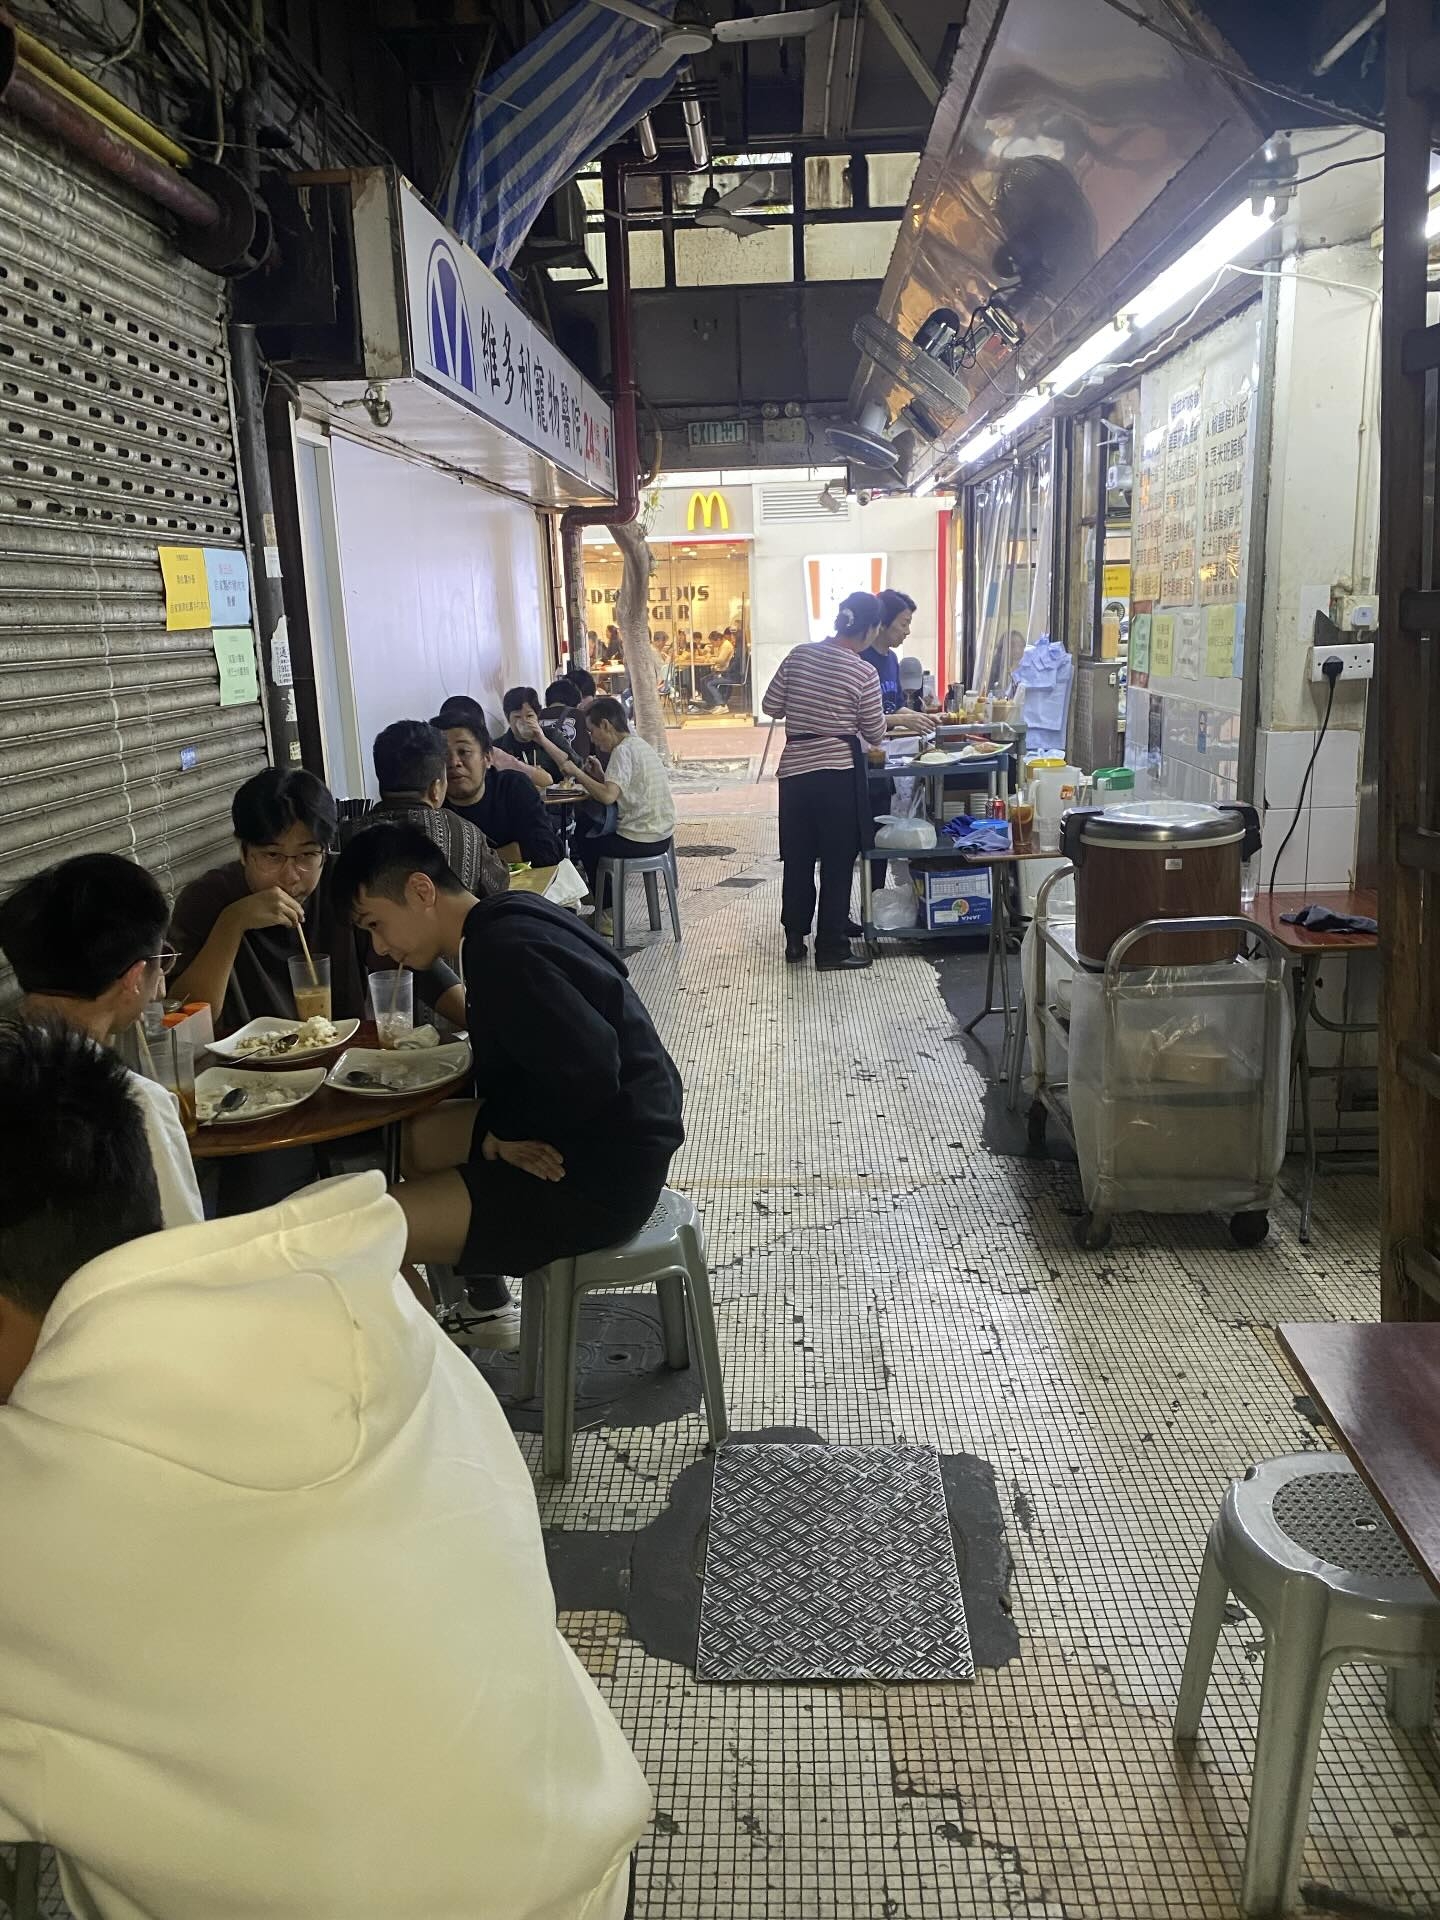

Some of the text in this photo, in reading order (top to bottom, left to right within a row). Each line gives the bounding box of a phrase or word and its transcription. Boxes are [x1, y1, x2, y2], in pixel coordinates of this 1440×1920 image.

[480, 304, 582, 456] 維多利寵物醫院
[691, 423, 745, 444] EXIT 出口
